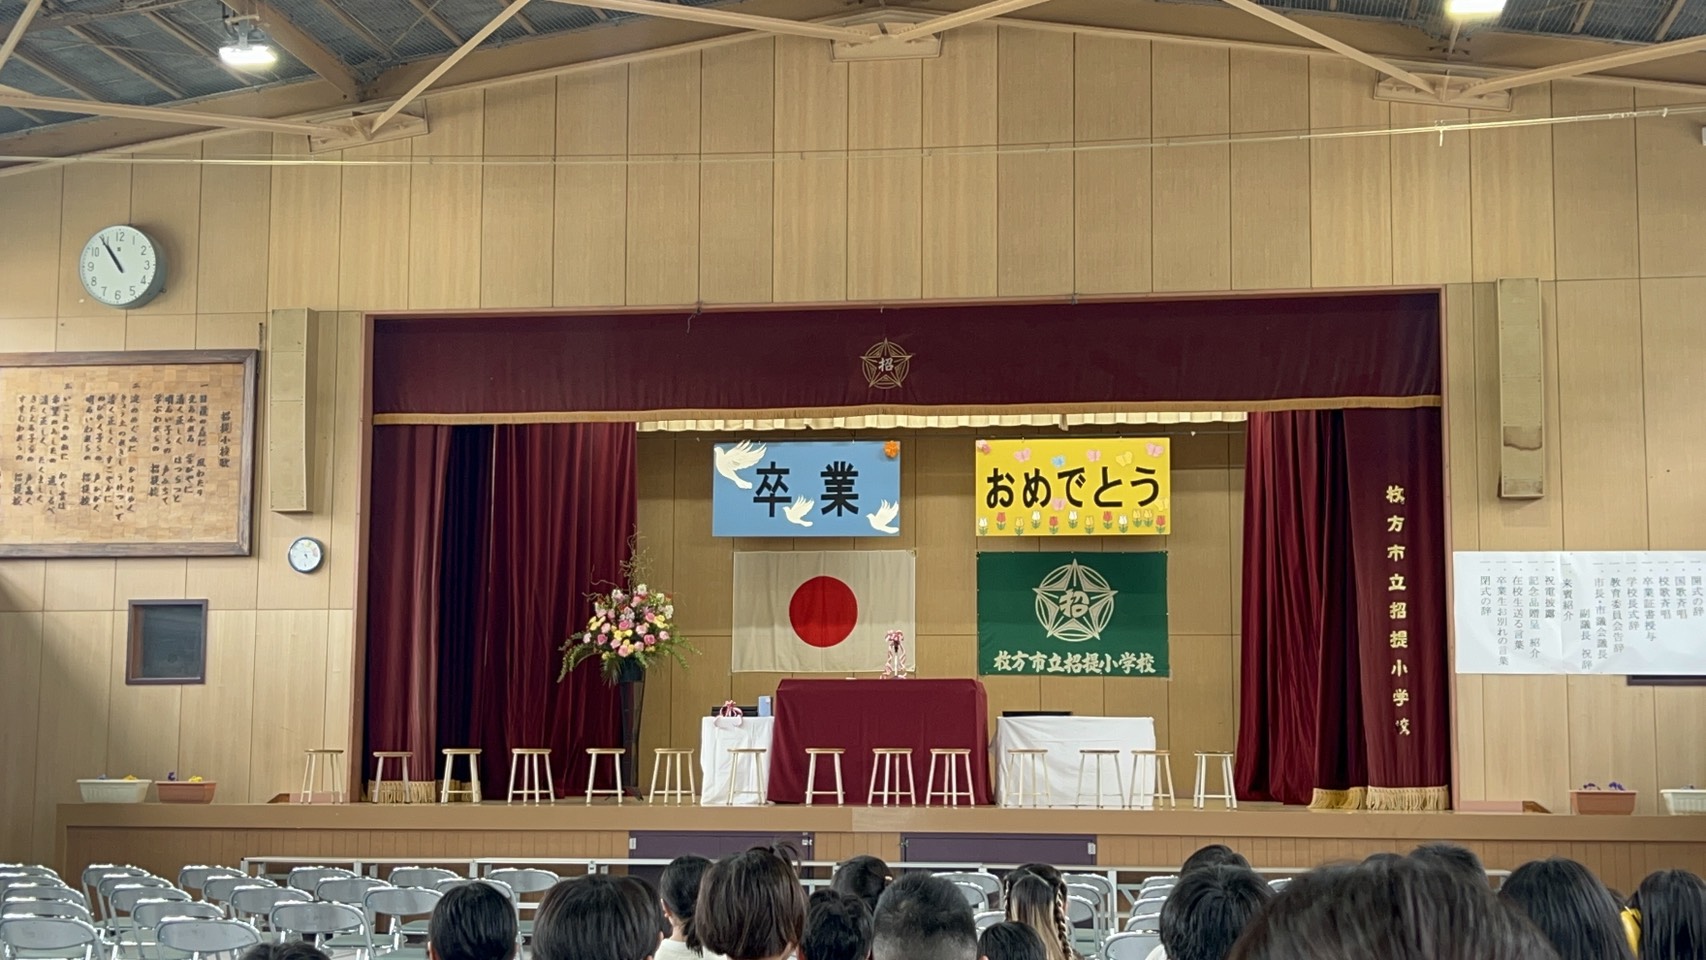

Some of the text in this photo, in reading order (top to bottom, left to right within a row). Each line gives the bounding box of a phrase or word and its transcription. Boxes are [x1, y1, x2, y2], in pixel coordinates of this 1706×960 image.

[116, 232, 125, 241] 12
[92, 247, 99, 257] 10
[141, 246, 146, 255] 2
[88, 262, 94, 271] 9
[144, 260, 150, 270] 3
[91, 277, 97, 286] 8
[140, 276, 146, 285] 4
[101, 287, 107, 296] 7
[115, 290, 121, 300] 6
[129, 286, 135, 295] 5
[878, 358, 894, 372] 招
[753, 461, 859, 517] 卒業
[986, 465, 1159, 509] おめでとう
[1059, 589, 1089, 617] 招
[1580, 609, 1593, 670] 副議長 祝辞
[1530, 638, 1540, 658] 紹介
[994, 651, 1155, 674] 枚方市立招提小学校
